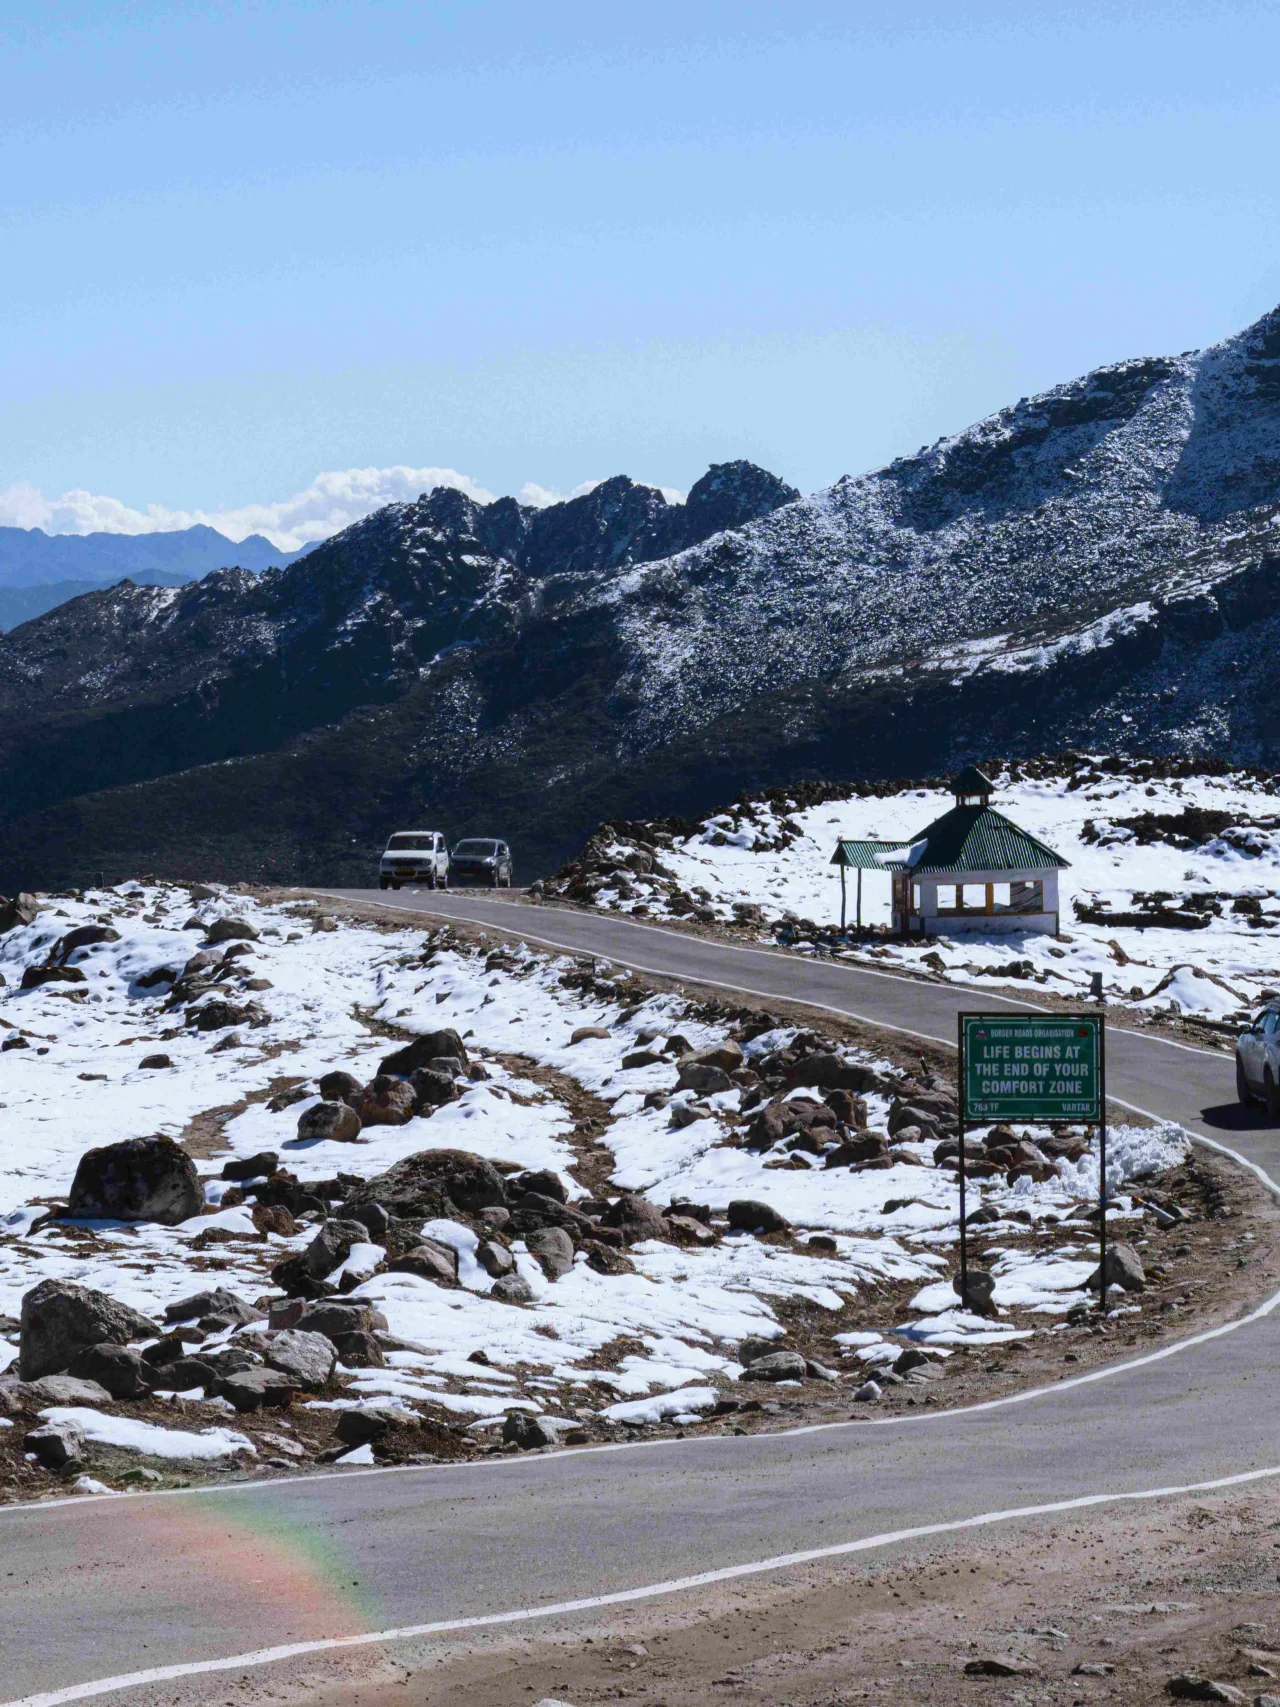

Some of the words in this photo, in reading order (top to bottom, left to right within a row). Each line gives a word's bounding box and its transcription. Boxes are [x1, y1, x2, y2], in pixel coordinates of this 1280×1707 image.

[990, 1029, 1013, 1038] BORDER
[1014, 1029, 1032, 1038] ROADS
[983, 1046, 1010, 1059] LIFE
[1014, 1046, 1061, 1059] BEGINS
[1065, 1046, 1080, 1059] AT
[975, 1063, 999, 1076] THE
[1004, 1063, 1029, 1076] END
[1033, 1063, 1050, 1076] OF
[1054, 1063, 1089, 1076] YOUR
[982, 1080, 1045, 1094] COMFORT
[1049, 1080, 1083, 1094] ZONE
[989, 1102, 1000, 1112] TF
[1062, 1102, 1091, 1112] VARTAK
